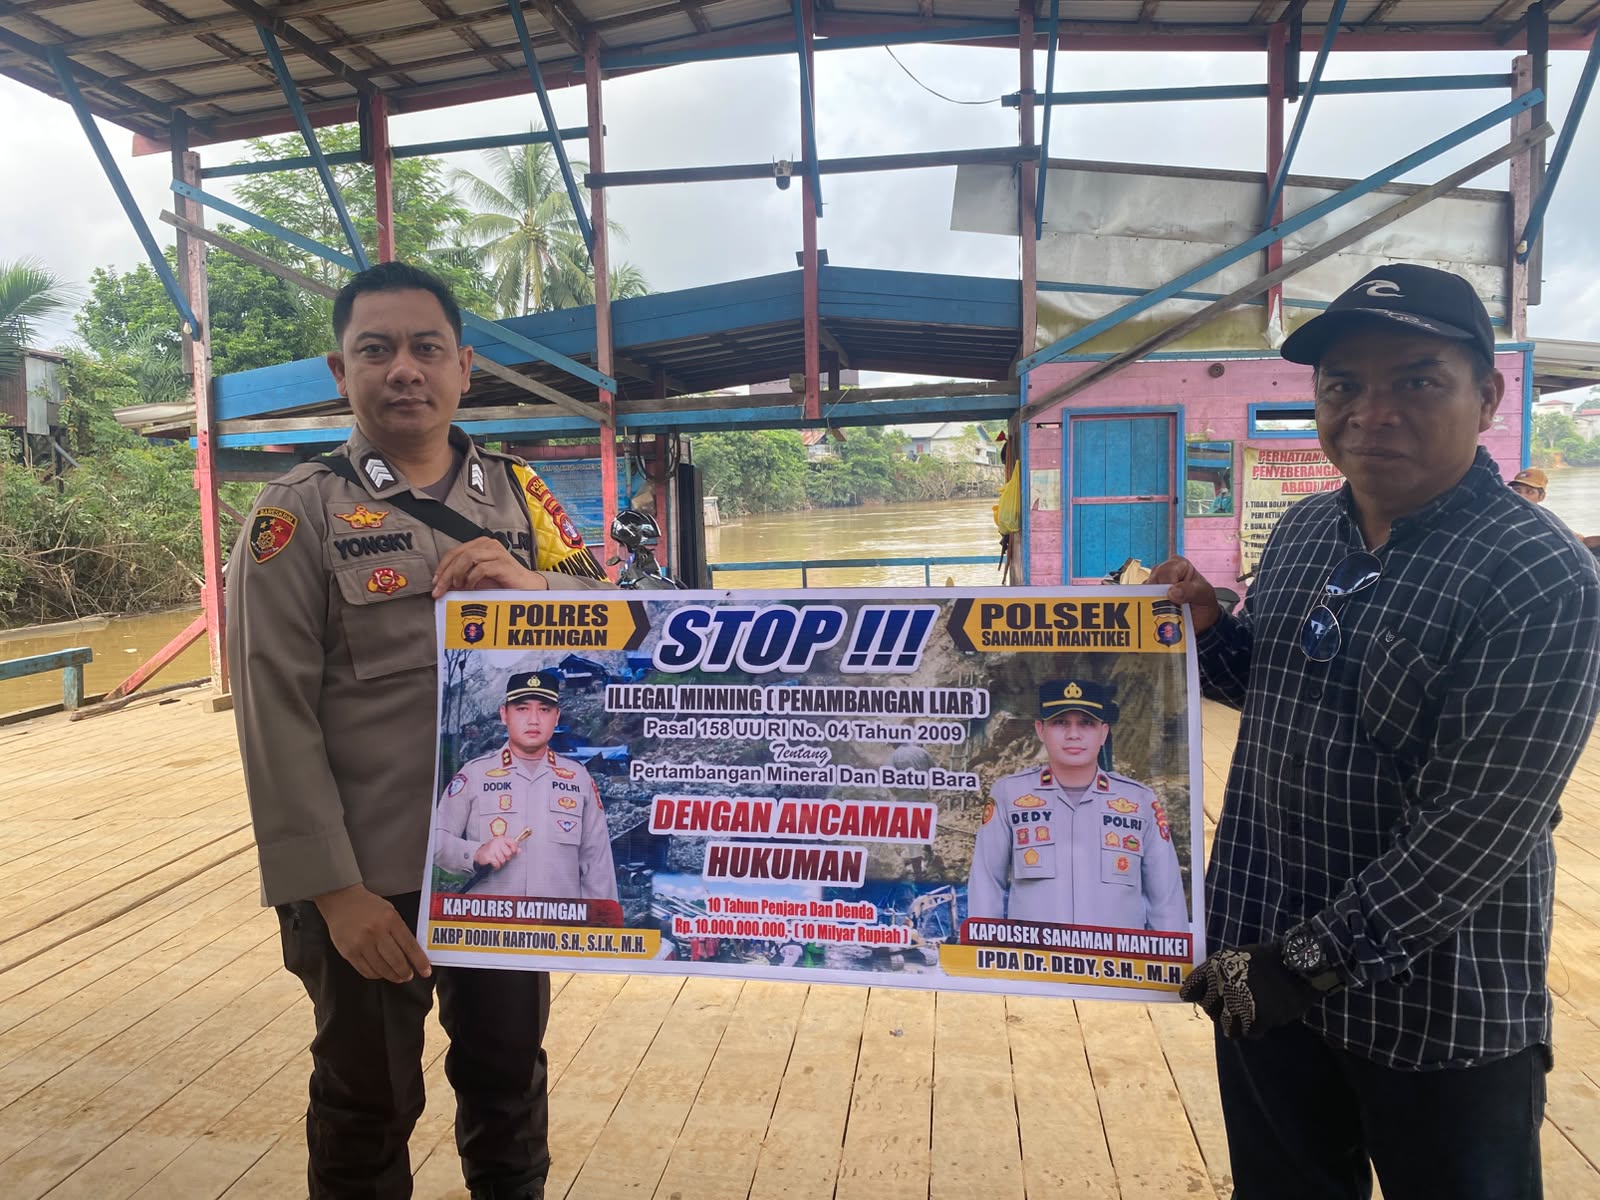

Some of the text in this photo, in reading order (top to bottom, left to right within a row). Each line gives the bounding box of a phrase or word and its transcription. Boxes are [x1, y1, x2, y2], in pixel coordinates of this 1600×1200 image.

[1258, 450, 1320, 462] PERHATIAN
[1252, 465, 1342, 477] PENYEBERANGA
[1281, 481, 1317, 492] ABADI
[334, 532, 414, 560] YONGKY
[509, 604, 608, 627] POLRES
[981, 602, 1130, 629] POLSEK
[508, 629, 608, 646] KATINGAN
[657, 608, 937, 668] STOP !!!
[982, 630, 1130, 647] SANAMAN MANTIKEI
[608, 687, 676, 711] ILLEGAL
[680, 688, 763, 712] MINNING
[778, 688, 924, 714] PENAMBANGAN
[929, 690, 972, 714] LIAR
[648, 720, 962, 741] Pasal 158 UU RI No. 04 Tahun 2009
[775, 744, 830, 763] Tentang
[483, 781, 512, 792] DODIK
[552, 781, 580, 793] POLRI
[633, 763, 977, 788] Pertambangan Mineral Dan Batu Bara
[653, 799, 932, 840] DENGAN ANCAMAN
[1011, 811, 1052, 824] DEDY
[1103, 815, 1142, 831] POLRI
[708, 846, 862, 882] HUKUMAN
[443, 898, 587, 921] KAPOLRES KATINGAN
[708, 897, 874, 920] 10 Tahun Penjara Dan Denda
[432, 927, 463, 945] AKBP
[465, 929, 500, 947] DODIK
[502, 931, 559, 951] HARTONO,
[621, 936, 646, 953] M.H.
[675, 918, 693, 936] Rp.
[802, 924, 815, 939] 10
[818, 924, 855, 943] Milyar
[858, 927, 902, 945] Rupiah
[969, 922, 1188, 957] KAPOLSEK SANAMAN MANTIKEI
[978, 950, 1185, 985] IPDA Dr. DEDY, S.H., M.H.
